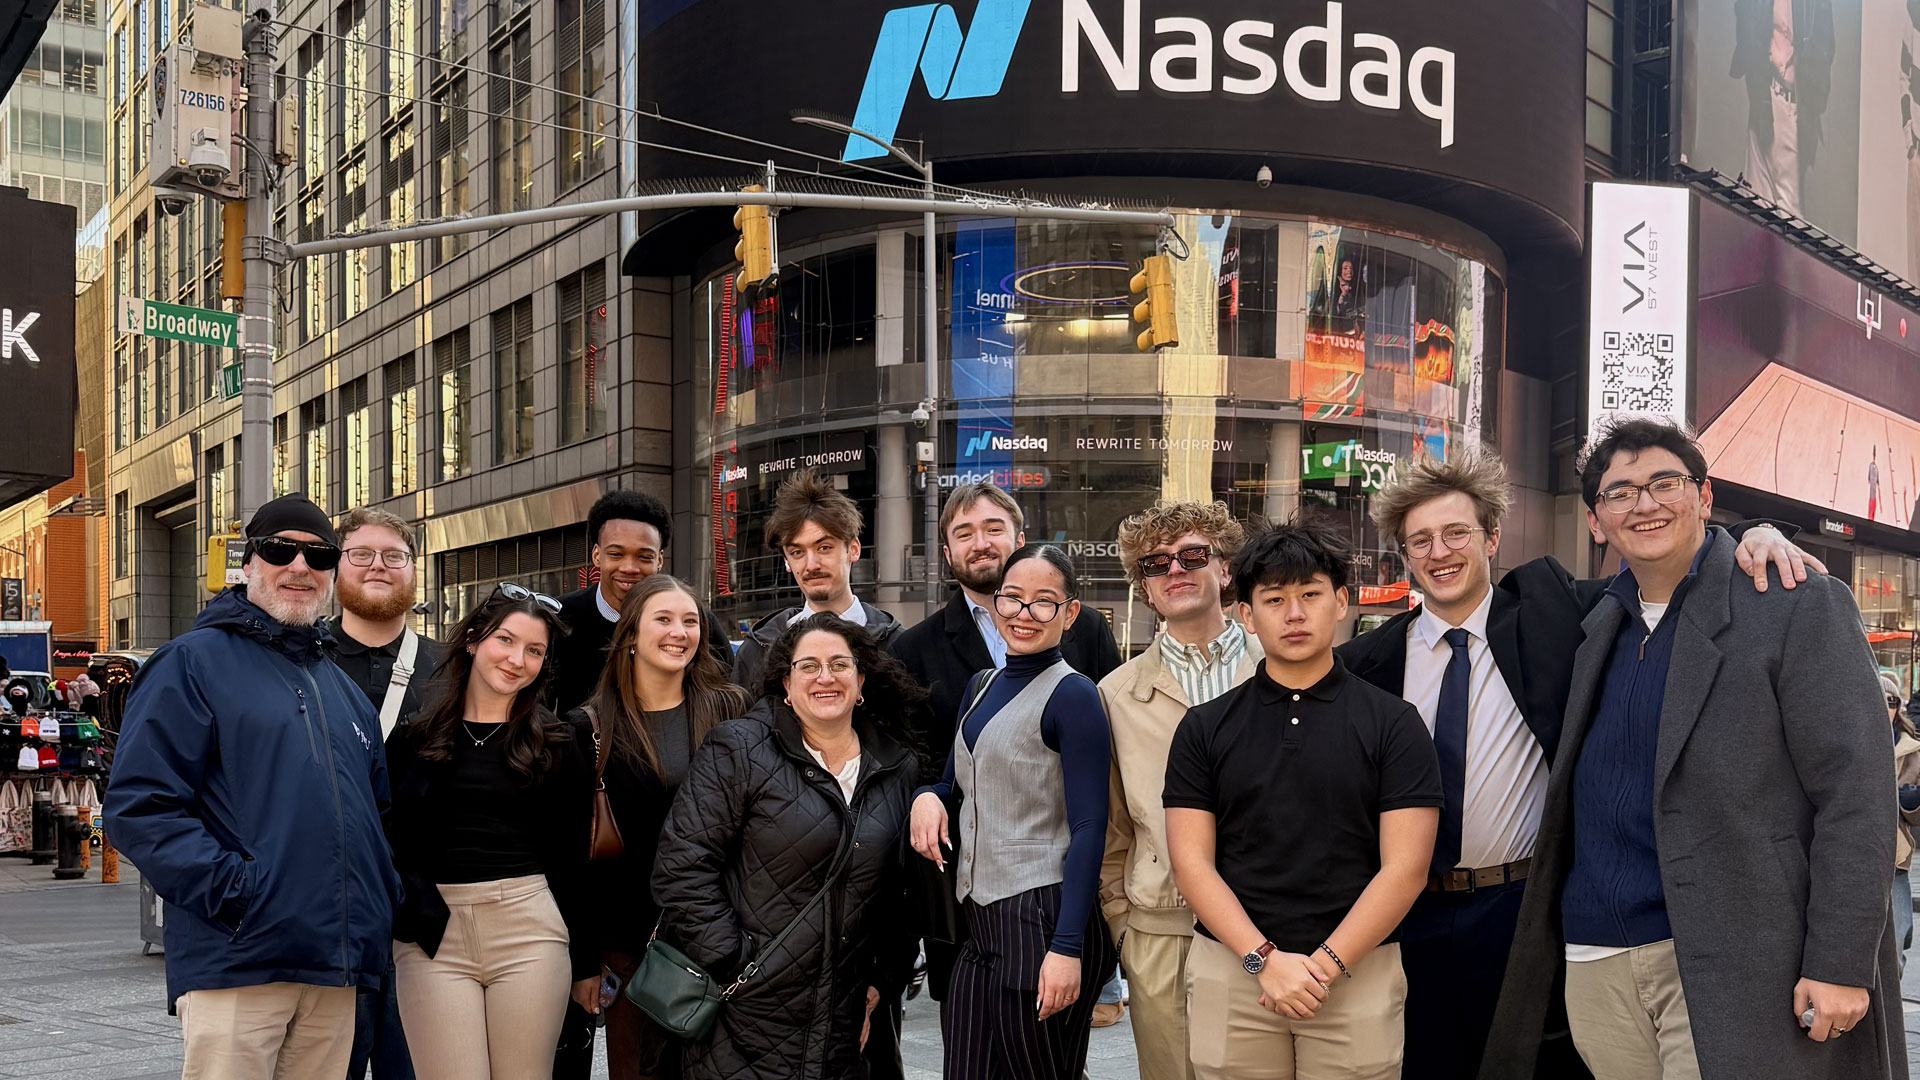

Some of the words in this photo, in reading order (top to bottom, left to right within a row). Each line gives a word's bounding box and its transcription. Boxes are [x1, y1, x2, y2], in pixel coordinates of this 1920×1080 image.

[1061, 0, 1456, 149] Nasdaq
[180, 88, 225, 112] 726156
[1648, 226, 1658, 281] WEST
[1622, 220, 1646, 314] VIA
[1648, 287, 1658, 310] 57
[2, 308, 41, 362] K
[145, 305, 233, 347] Broadway
[225, 369, 234, 396] W
[992, 435, 1048, 453] Nasdaq
[1076, 437, 1142, 450] REWRITE
[1149, 438, 1233, 452] TOMORROW
[759, 457, 796, 474] REWRITE
[1354, 448, 1396, 467] Nasdaq
[725, 466, 748, 482] Nasdaq
[921, 469, 1044, 489] andedcities
[227, 549, 245, 558] Time
[1067, 539, 1119, 557] Nasd
[1351, 554, 1373, 569] sdaq
